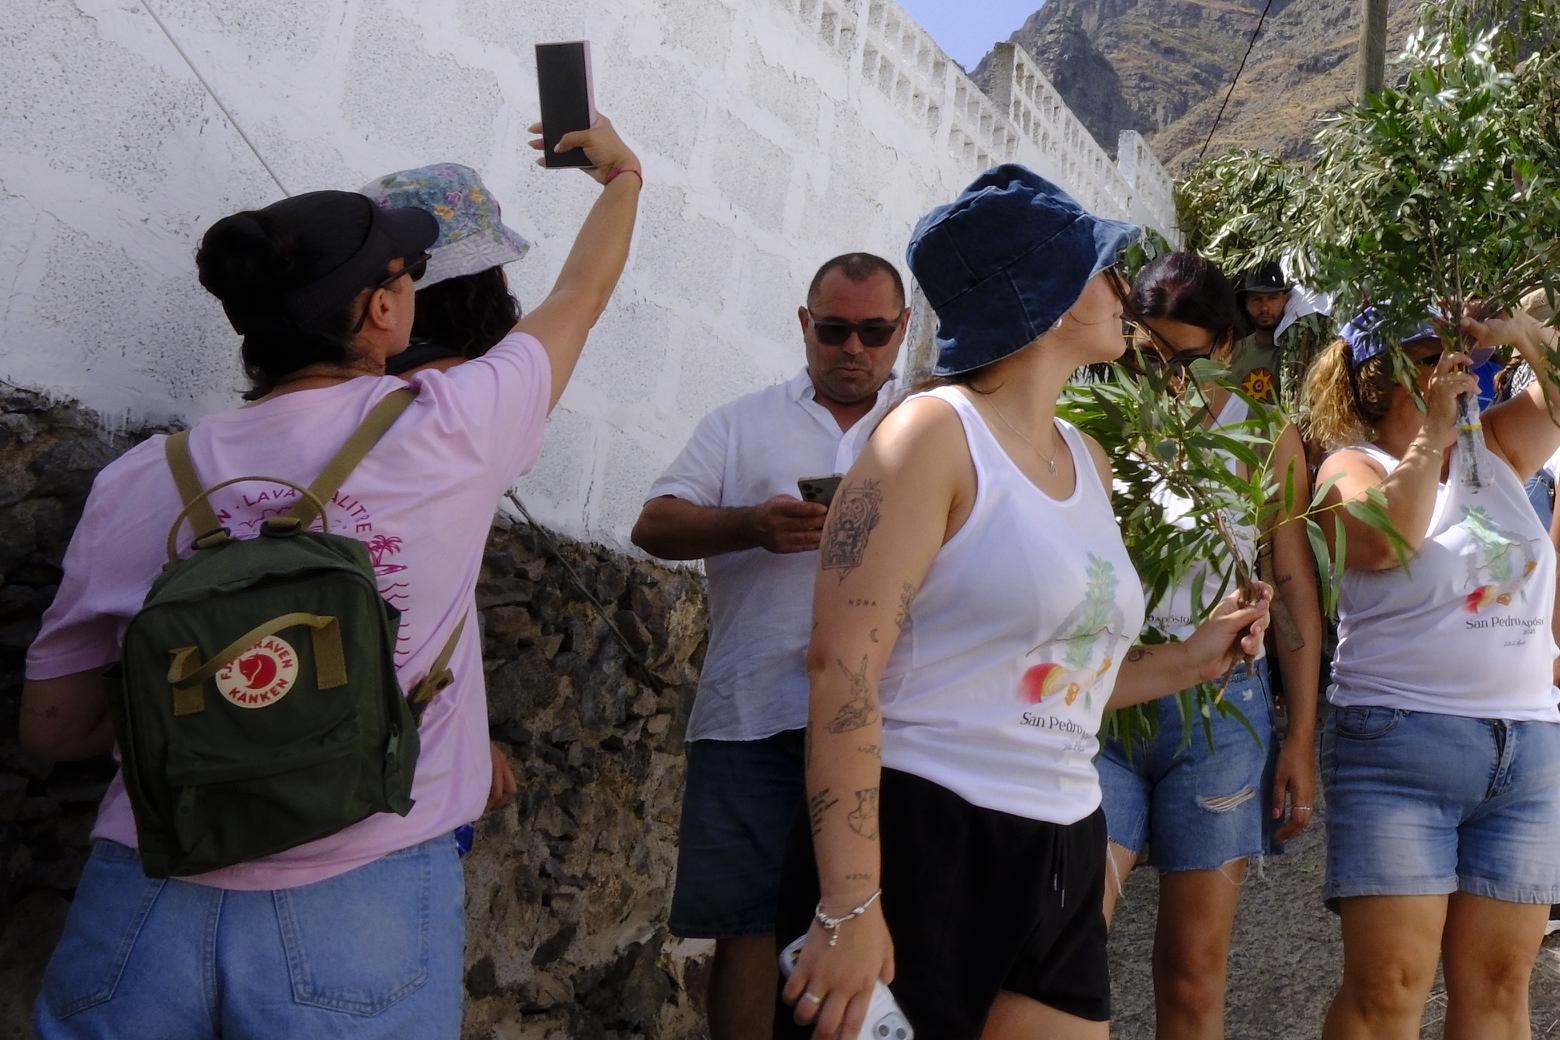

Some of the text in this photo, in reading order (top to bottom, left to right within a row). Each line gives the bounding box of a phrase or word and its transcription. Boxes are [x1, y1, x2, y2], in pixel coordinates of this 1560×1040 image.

[243, 488, 296, 507] LAVA
[1465, 620, 1488, 630] San
[1492, 616, 1521, 627] Pedro
[1019, 711, 1045, 728] San
[1048, 715, 1083, 735] Pedro
